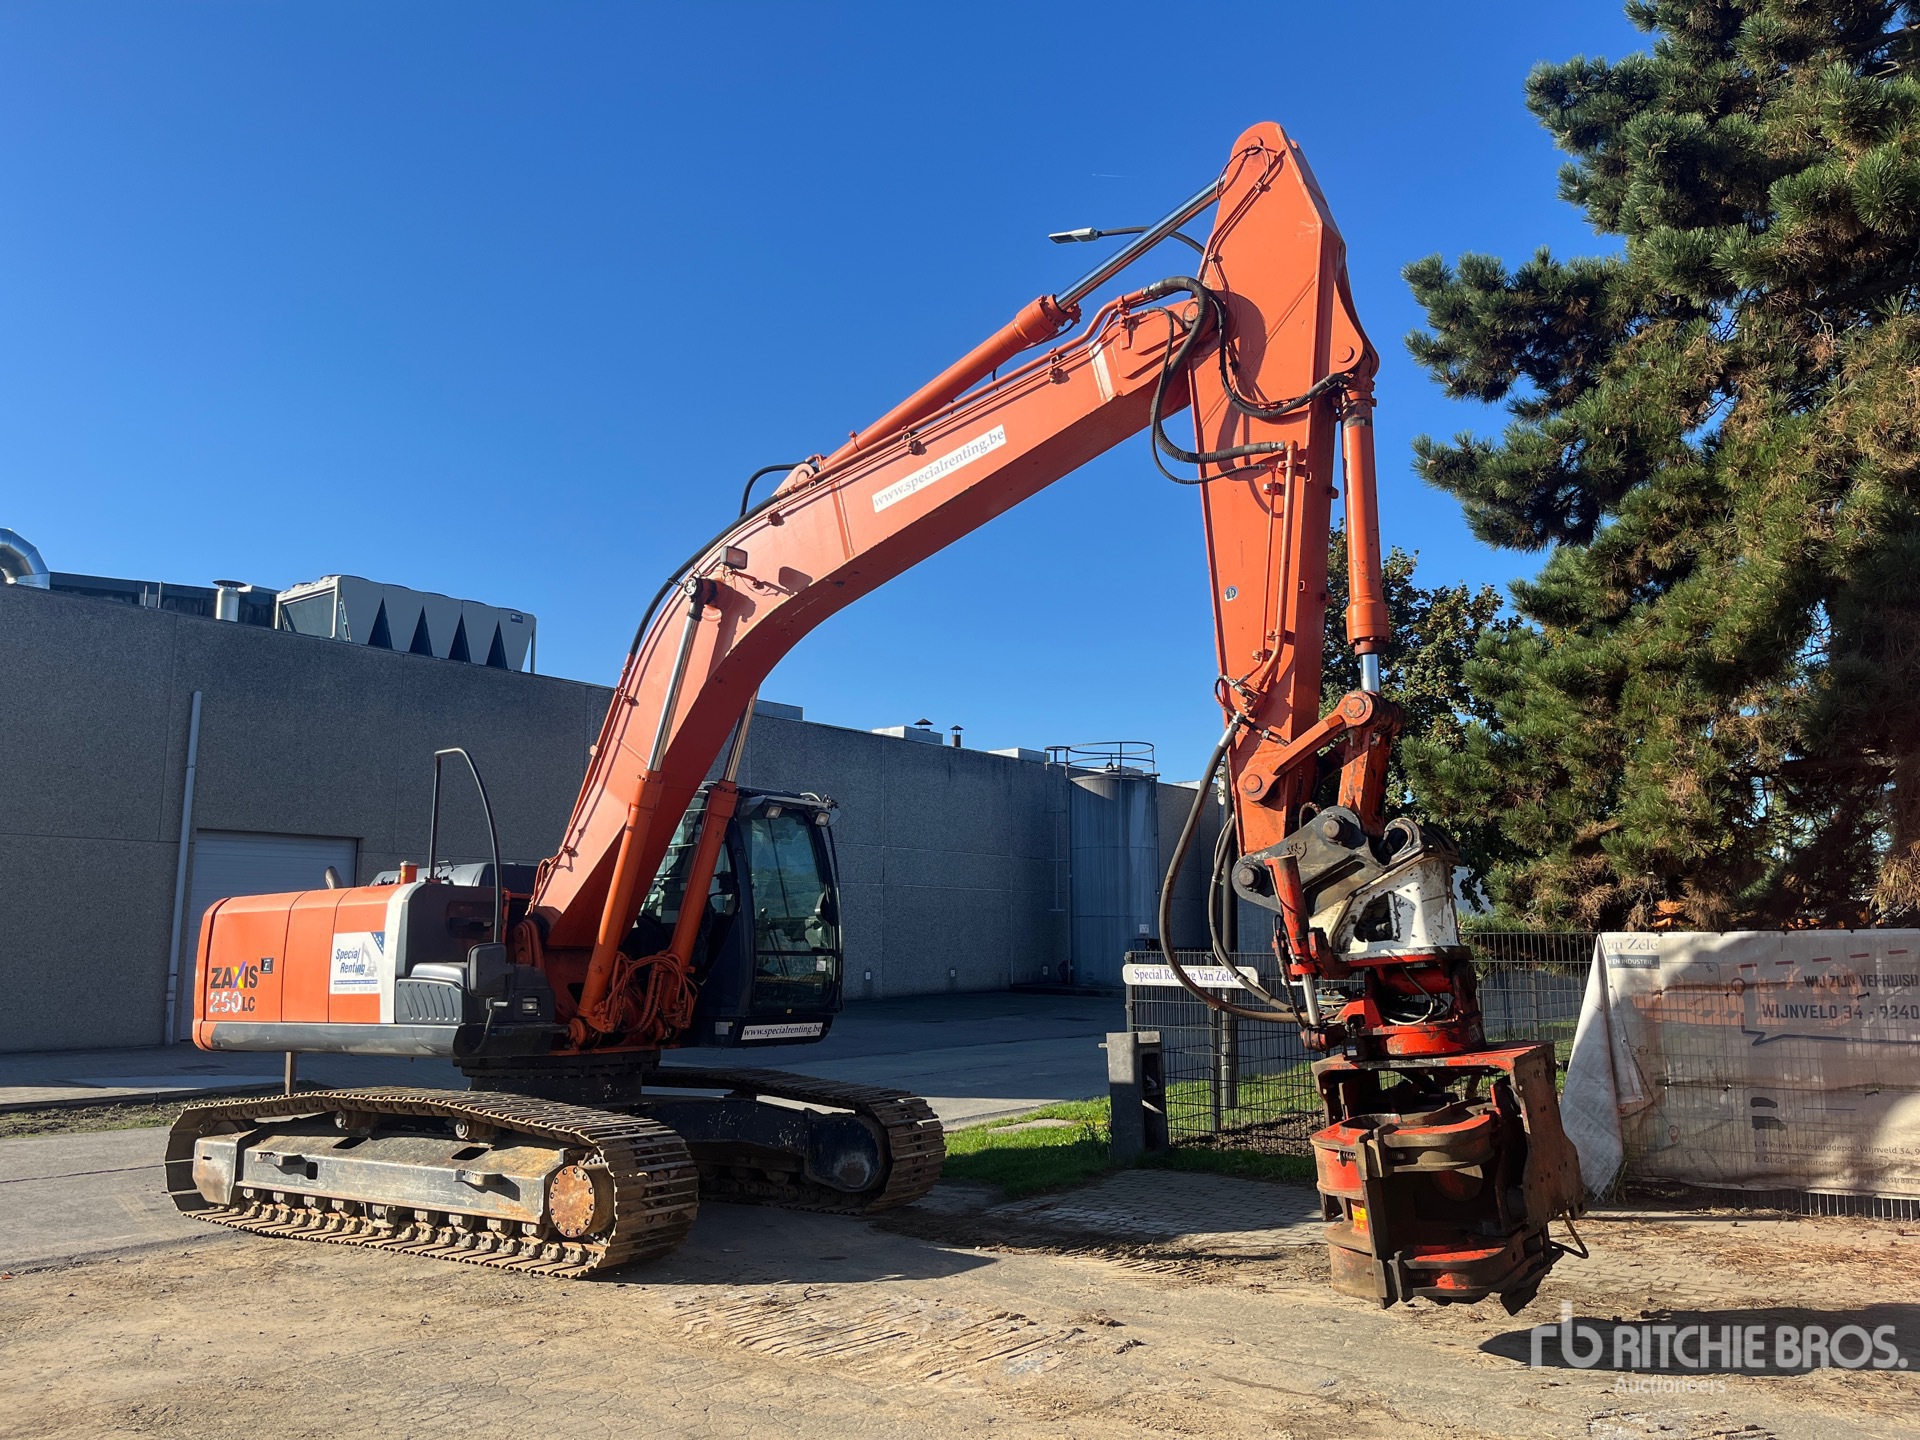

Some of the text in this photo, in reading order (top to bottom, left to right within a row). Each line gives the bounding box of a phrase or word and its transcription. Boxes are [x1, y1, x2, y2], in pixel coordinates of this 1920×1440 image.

[874, 430, 1004, 506] www.specialrenting.be
[1627, 938, 1658, 951] Zele
[336, 948, 361, 963] Special
[1621, 958, 1653, 966] INDUSTRIE
[210, 961, 259, 989] ZAXIS
[340, 962, 366, 976] Renting
[1134, 968, 1234, 982] Special Reng Van Zele
[1803, 975, 1826, 988] WIJ
[1829, 975, 1856, 988] ZIJN
[1762, 1004, 1838, 1019] WIJNVELD
[1843, 1005, 1864, 1019] 34
[1879, 1005, 1920, 1020] 9240
[744, 1025, 822, 1037] www.specialrenting.be
[1860, 1145, 1897, 1154] Wijnveld
